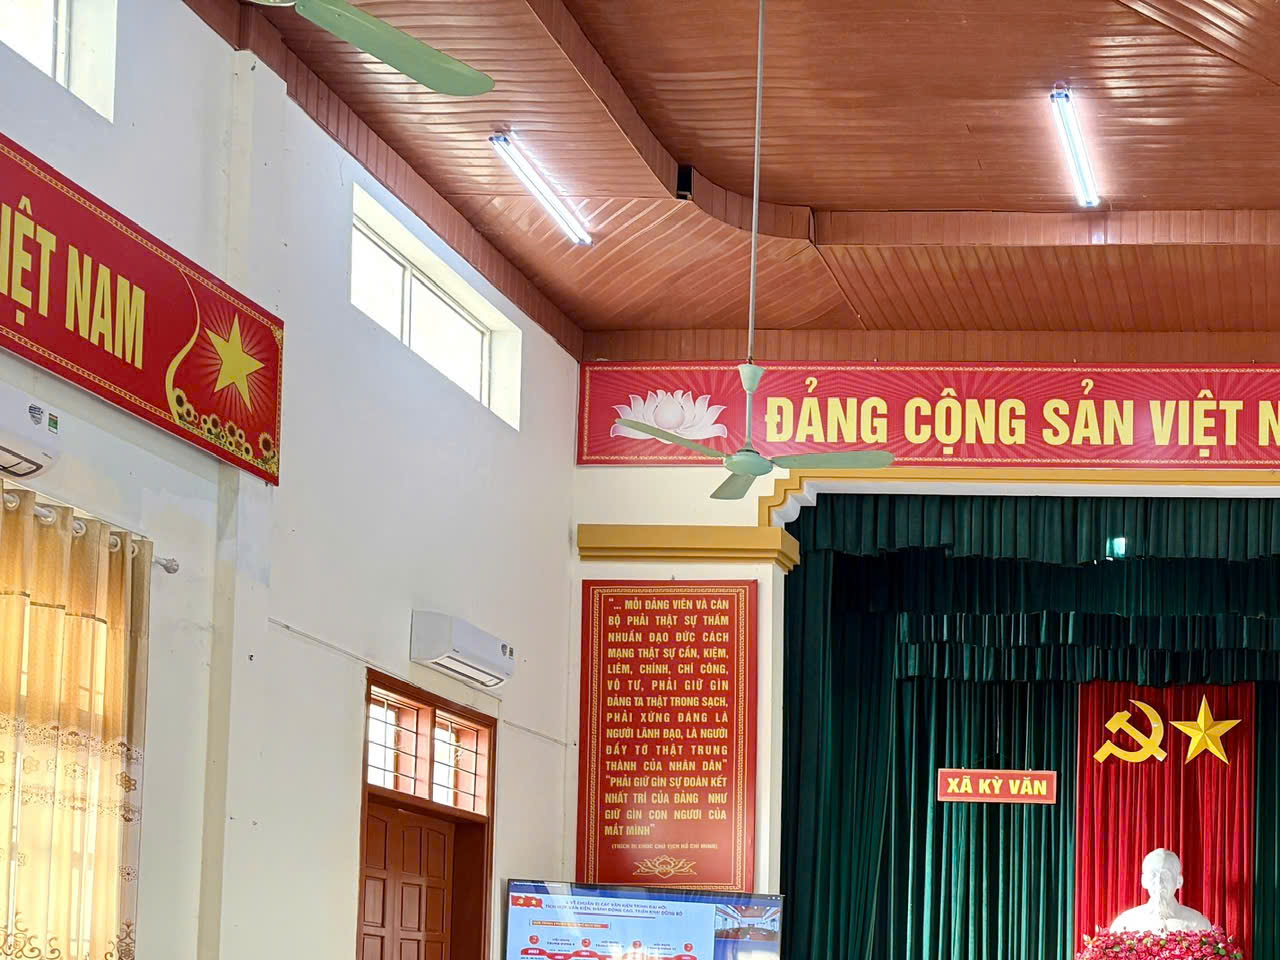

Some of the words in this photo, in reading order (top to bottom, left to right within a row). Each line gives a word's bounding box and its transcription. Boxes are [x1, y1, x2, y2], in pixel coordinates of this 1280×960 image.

[0, 195, 57, 326] IỆT
[65, 244, 146, 370] NAM
[765, 377, 888, 444] ĐẢNG
[904, 387, 1026, 455] CỘNG
[1041, 378, 1134, 447] SẢN
[1146, 388, 1243, 458] VIỆT
[645, 597, 670, 610] ĐẢNG
[672, 598, 693, 610] VIÊN
[696, 598, 708, 610] VÀ
[710, 598, 729, 610] CÁN
[627, 613, 649, 626] PHẢI
[649, 632, 669, 644] ĐẠO
[702, 630, 729, 642] CÁCH
[608, 648, 635, 660] MẠNG
[678, 662, 694, 674] CHÍ
[607, 678, 620, 690] VÔ
[651, 677, 677, 690] PHẢI
[607, 694, 632, 707] ĐẢNG
[634, 696, 644, 707] TA
[670, 696, 700, 707] TRONG
[606, 710, 632, 722] PHẢI
[677, 710, 708, 722] ĐÁNG
[715, 710, 728, 722] LÀ
[636, 726, 660, 738] LÃNH
[686, 726, 698, 738] LÀ
[691, 745, 728, 755] TRUNG
[606, 759, 637, 771] THÀNH
[643, 758, 662, 771] CỦA
[669, 759, 696, 771] NHÂN
[684, 775, 709, 787] ĐOÀN
[946, 775, 973, 794] XÃ
[978, 775, 1004, 794] KỲ
[1008, 776, 1047, 796] VĂN
